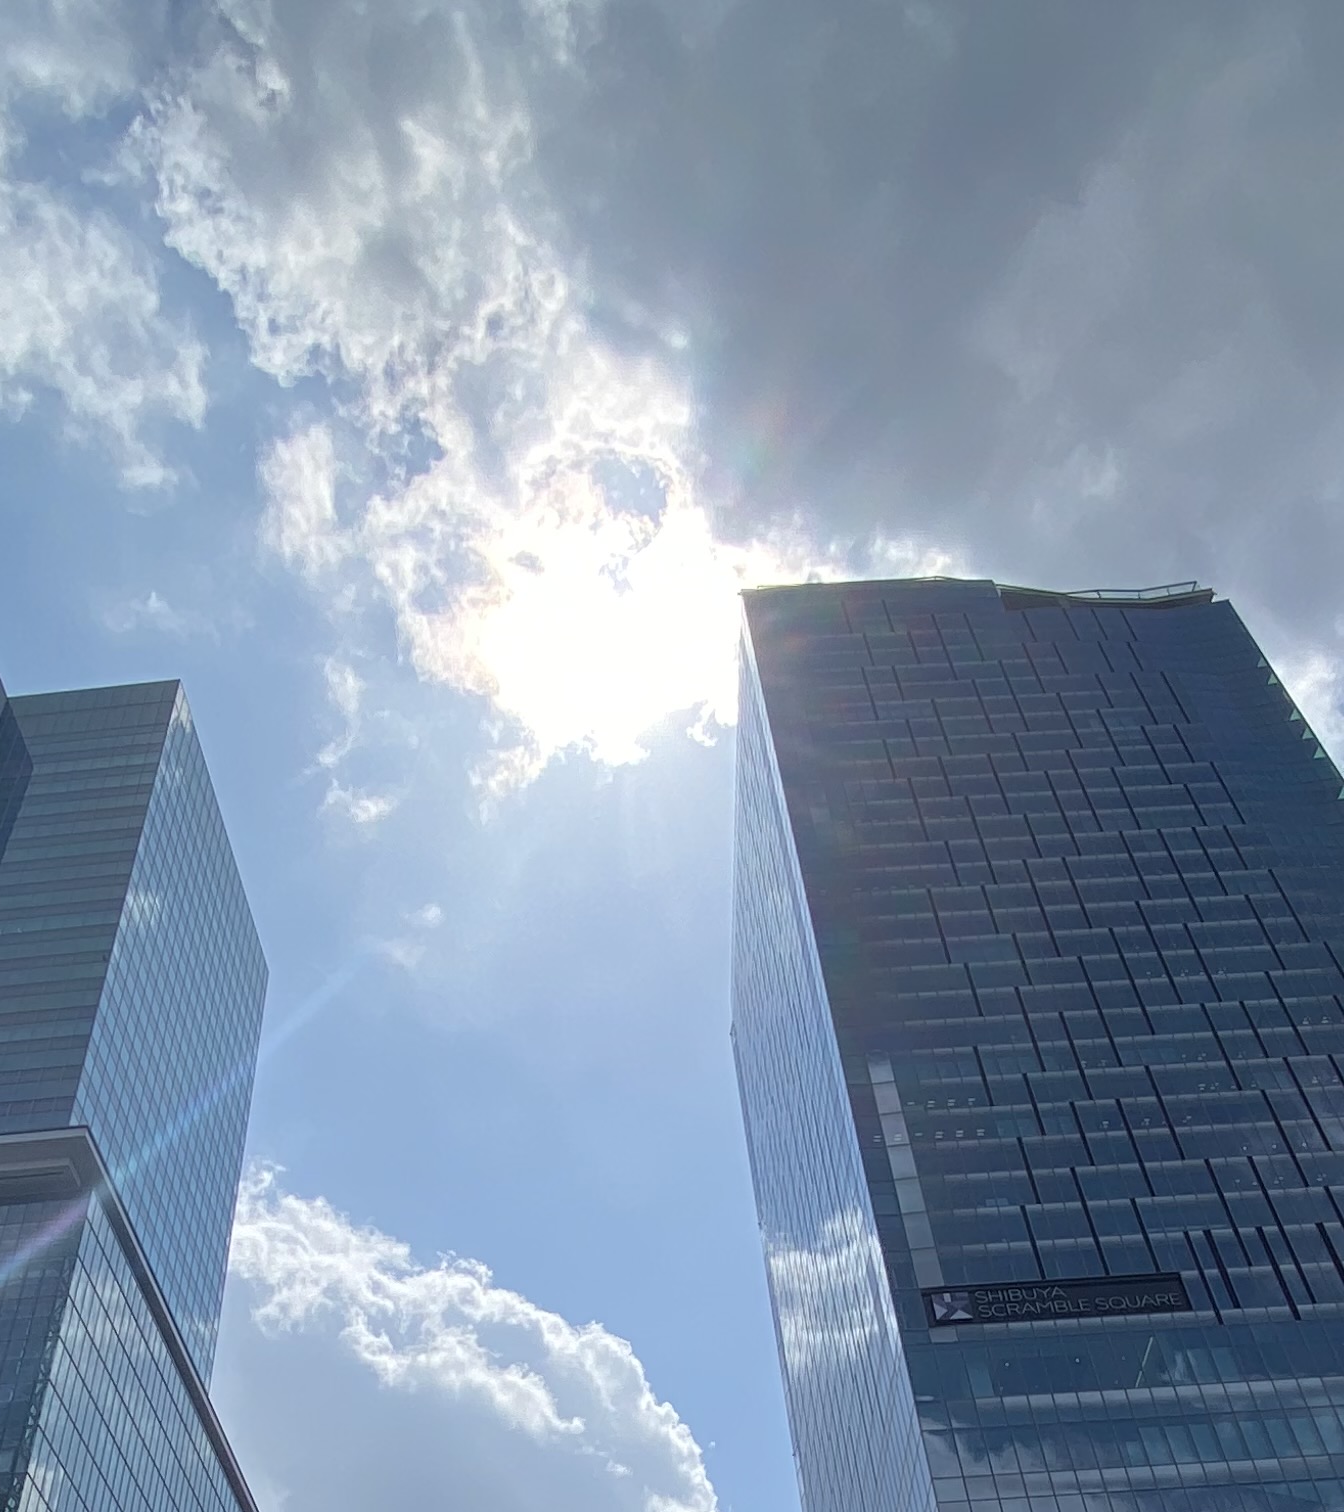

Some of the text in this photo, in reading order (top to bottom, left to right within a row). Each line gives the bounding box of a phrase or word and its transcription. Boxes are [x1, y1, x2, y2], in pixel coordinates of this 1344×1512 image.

[974, 1286, 1068, 1305] SHIBUYA
[979, 1293, 1184, 1318] SCRAMBLE SQUARE
